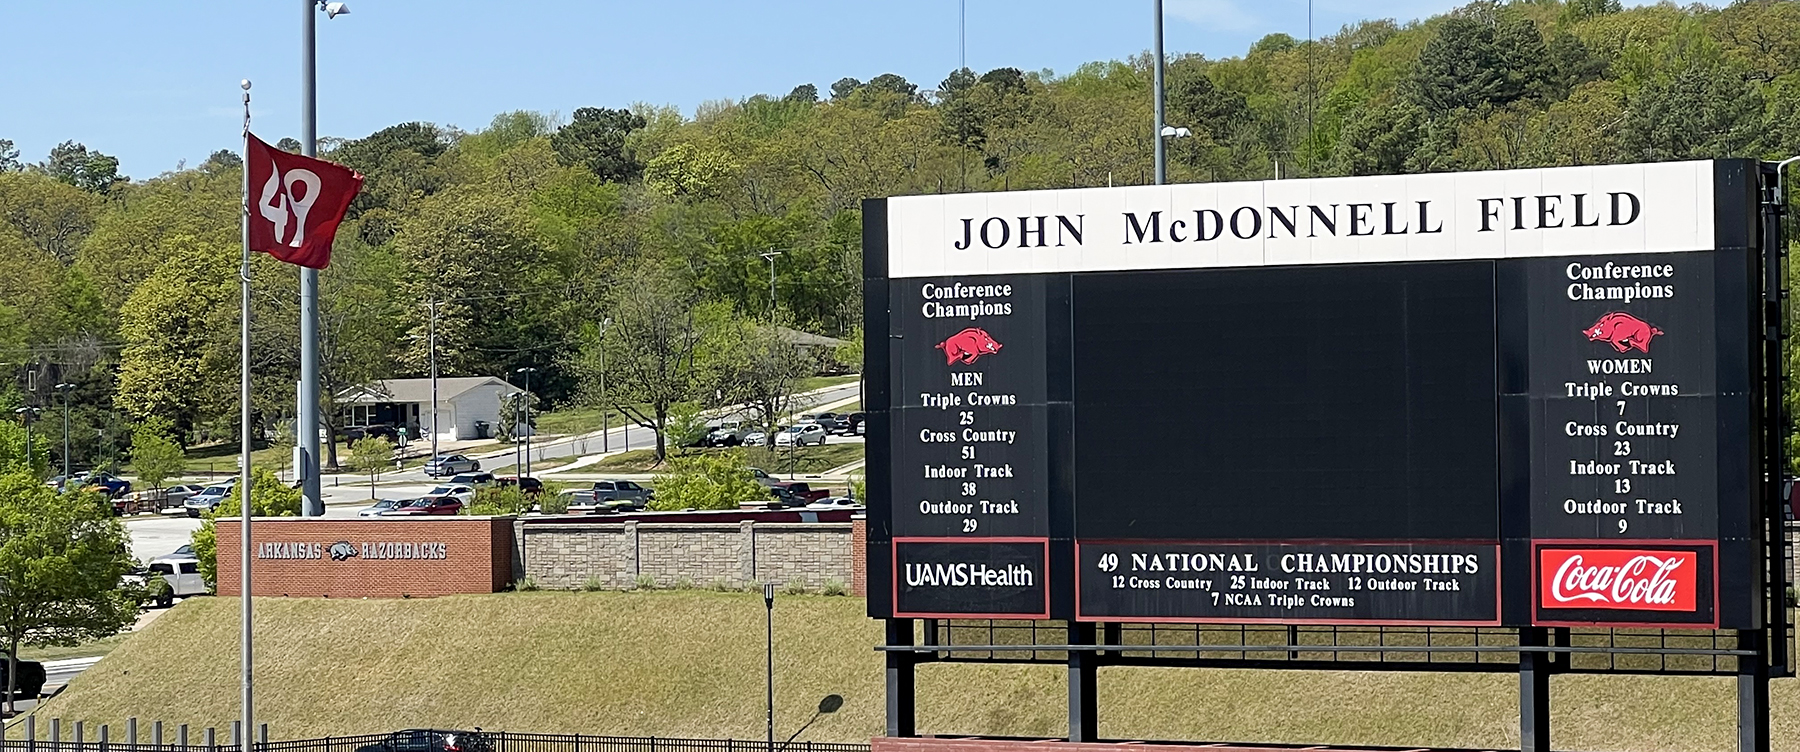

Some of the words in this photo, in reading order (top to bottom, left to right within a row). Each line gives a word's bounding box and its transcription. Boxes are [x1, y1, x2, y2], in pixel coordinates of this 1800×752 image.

[259, 158, 322, 248] 49
[954, 214, 1085, 251] JOHN
[1121, 200, 1443, 245] McDONNELL
[1477, 191, 1641, 233] FIELD
[1565, 261, 1674, 281] Conference
[921, 282, 1012, 300] Conference
[1567, 281, 1674, 304] Champions
[922, 299, 1012, 321] Champions
[1586, 358, 1652, 375] WOMEN
[950, 372, 983, 387] MEN
[1564, 381, 1613, 401] Triple
[1620, 381, 1679, 397] Crowns
[920, 392, 962, 410] Triple
[967, 391, 1016, 406] Crowns
[1616, 400, 1626, 416] 7
[959, 411, 974, 426] 25
[919, 428, 957, 443] Cross
[962, 427, 1016, 445] Country
[1564, 421, 1608, 437] Cross
[1615, 420, 1680, 439] Country
[961, 445, 976, 460] 51
[1613, 440, 1631, 456] 23
[924, 464, 968, 479] Indoor
[973, 463, 1014, 478] Track
[1569, 459, 1621, 475] Indoor
[1628, 459, 1676, 475] Track
[961, 481, 977, 496] 38
[1614, 478, 1631, 494] 13
[919, 500, 974, 514] Outdoor
[979, 499, 1019, 514] Track
[1563, 499, 1628, 515] Outdoor
[1635, 499, 1683, 514] Track
[962, 518, 978, 533] 29
[1618, 518, 1628, 534] 9
[258, 542, 322, 560] ARKANSAS
[362, 542, 447, 560] RAZORBACKS
[1097, 553, 1119, 572] 49
[1131, 553, 1259, 572] NATIONAL
[1280, 553, 1479, 574] CHAMPIONSHIPS
[1112, 575, 1126, 589] 12
[1129, 576, 1161, 589] Cross
[1165, 576, 1213, 592] Country
[1230, 574, 1246, 590] 25
[1250, 576, 1290, 590] Indoor
[1294, 577, 1331, 591] Track
[1347, 576, 1362, 591] 12
[1367, 577, 1418, 591] Outdoor
[1422, 578, 1460, 591] Track
[1211, 591, 1220, 607] 7
[1224, 593, 1262, 606] NCAA
[1267, 593, 1305, 610] Triple
[1310, 594, 1355, 607] Crowns
